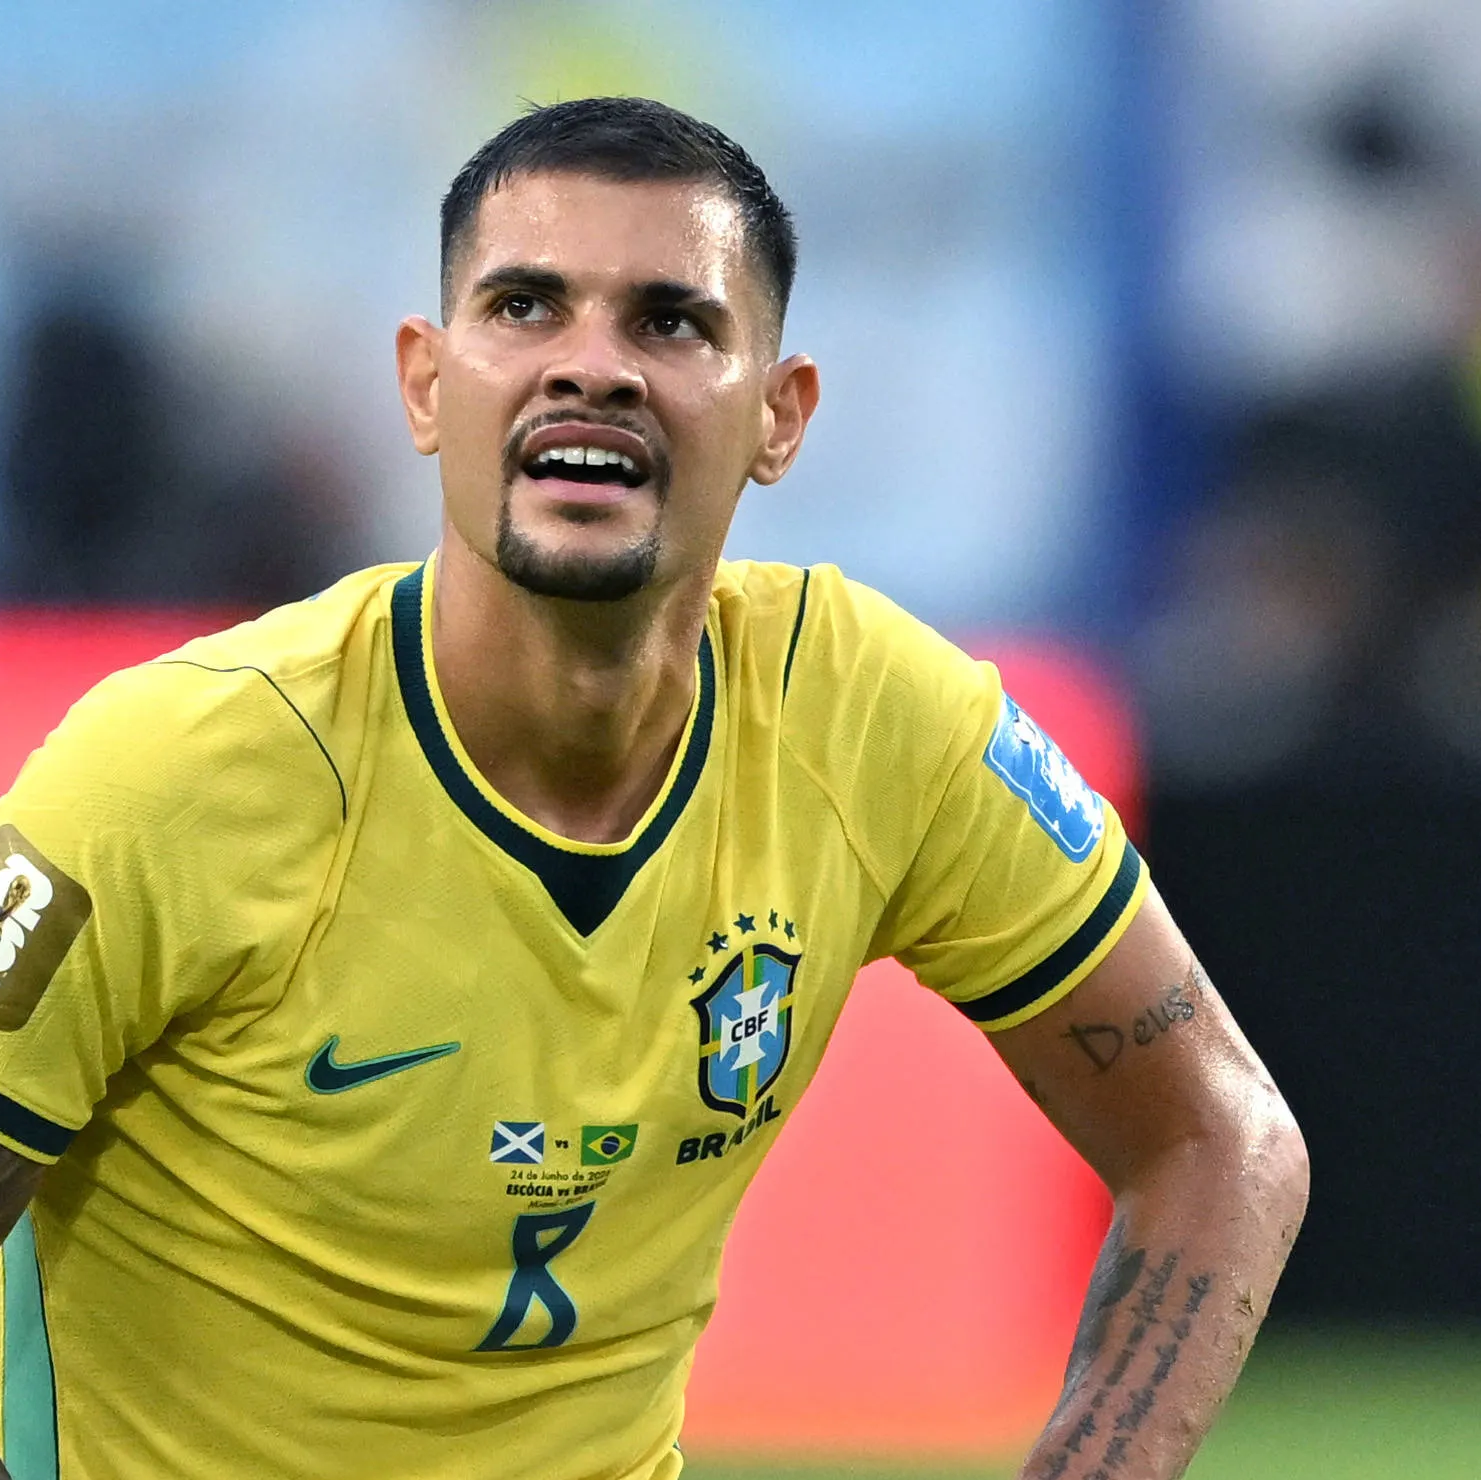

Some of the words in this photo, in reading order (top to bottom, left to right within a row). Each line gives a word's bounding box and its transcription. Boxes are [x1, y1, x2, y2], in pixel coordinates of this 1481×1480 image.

[731, 1009, 769, 1042] CBF
[554, 1139, 569, 1149] vs
[510, 1169, 523, 1180] 24
[526, 1169, 538, 1181] de
[572, 1169, 585, 1181] de
[506, 1182, 554, 1197] ESCÓCIA
[557, 1187, 570, 1197] vs
[471, 1201, 596, 1352] 8
